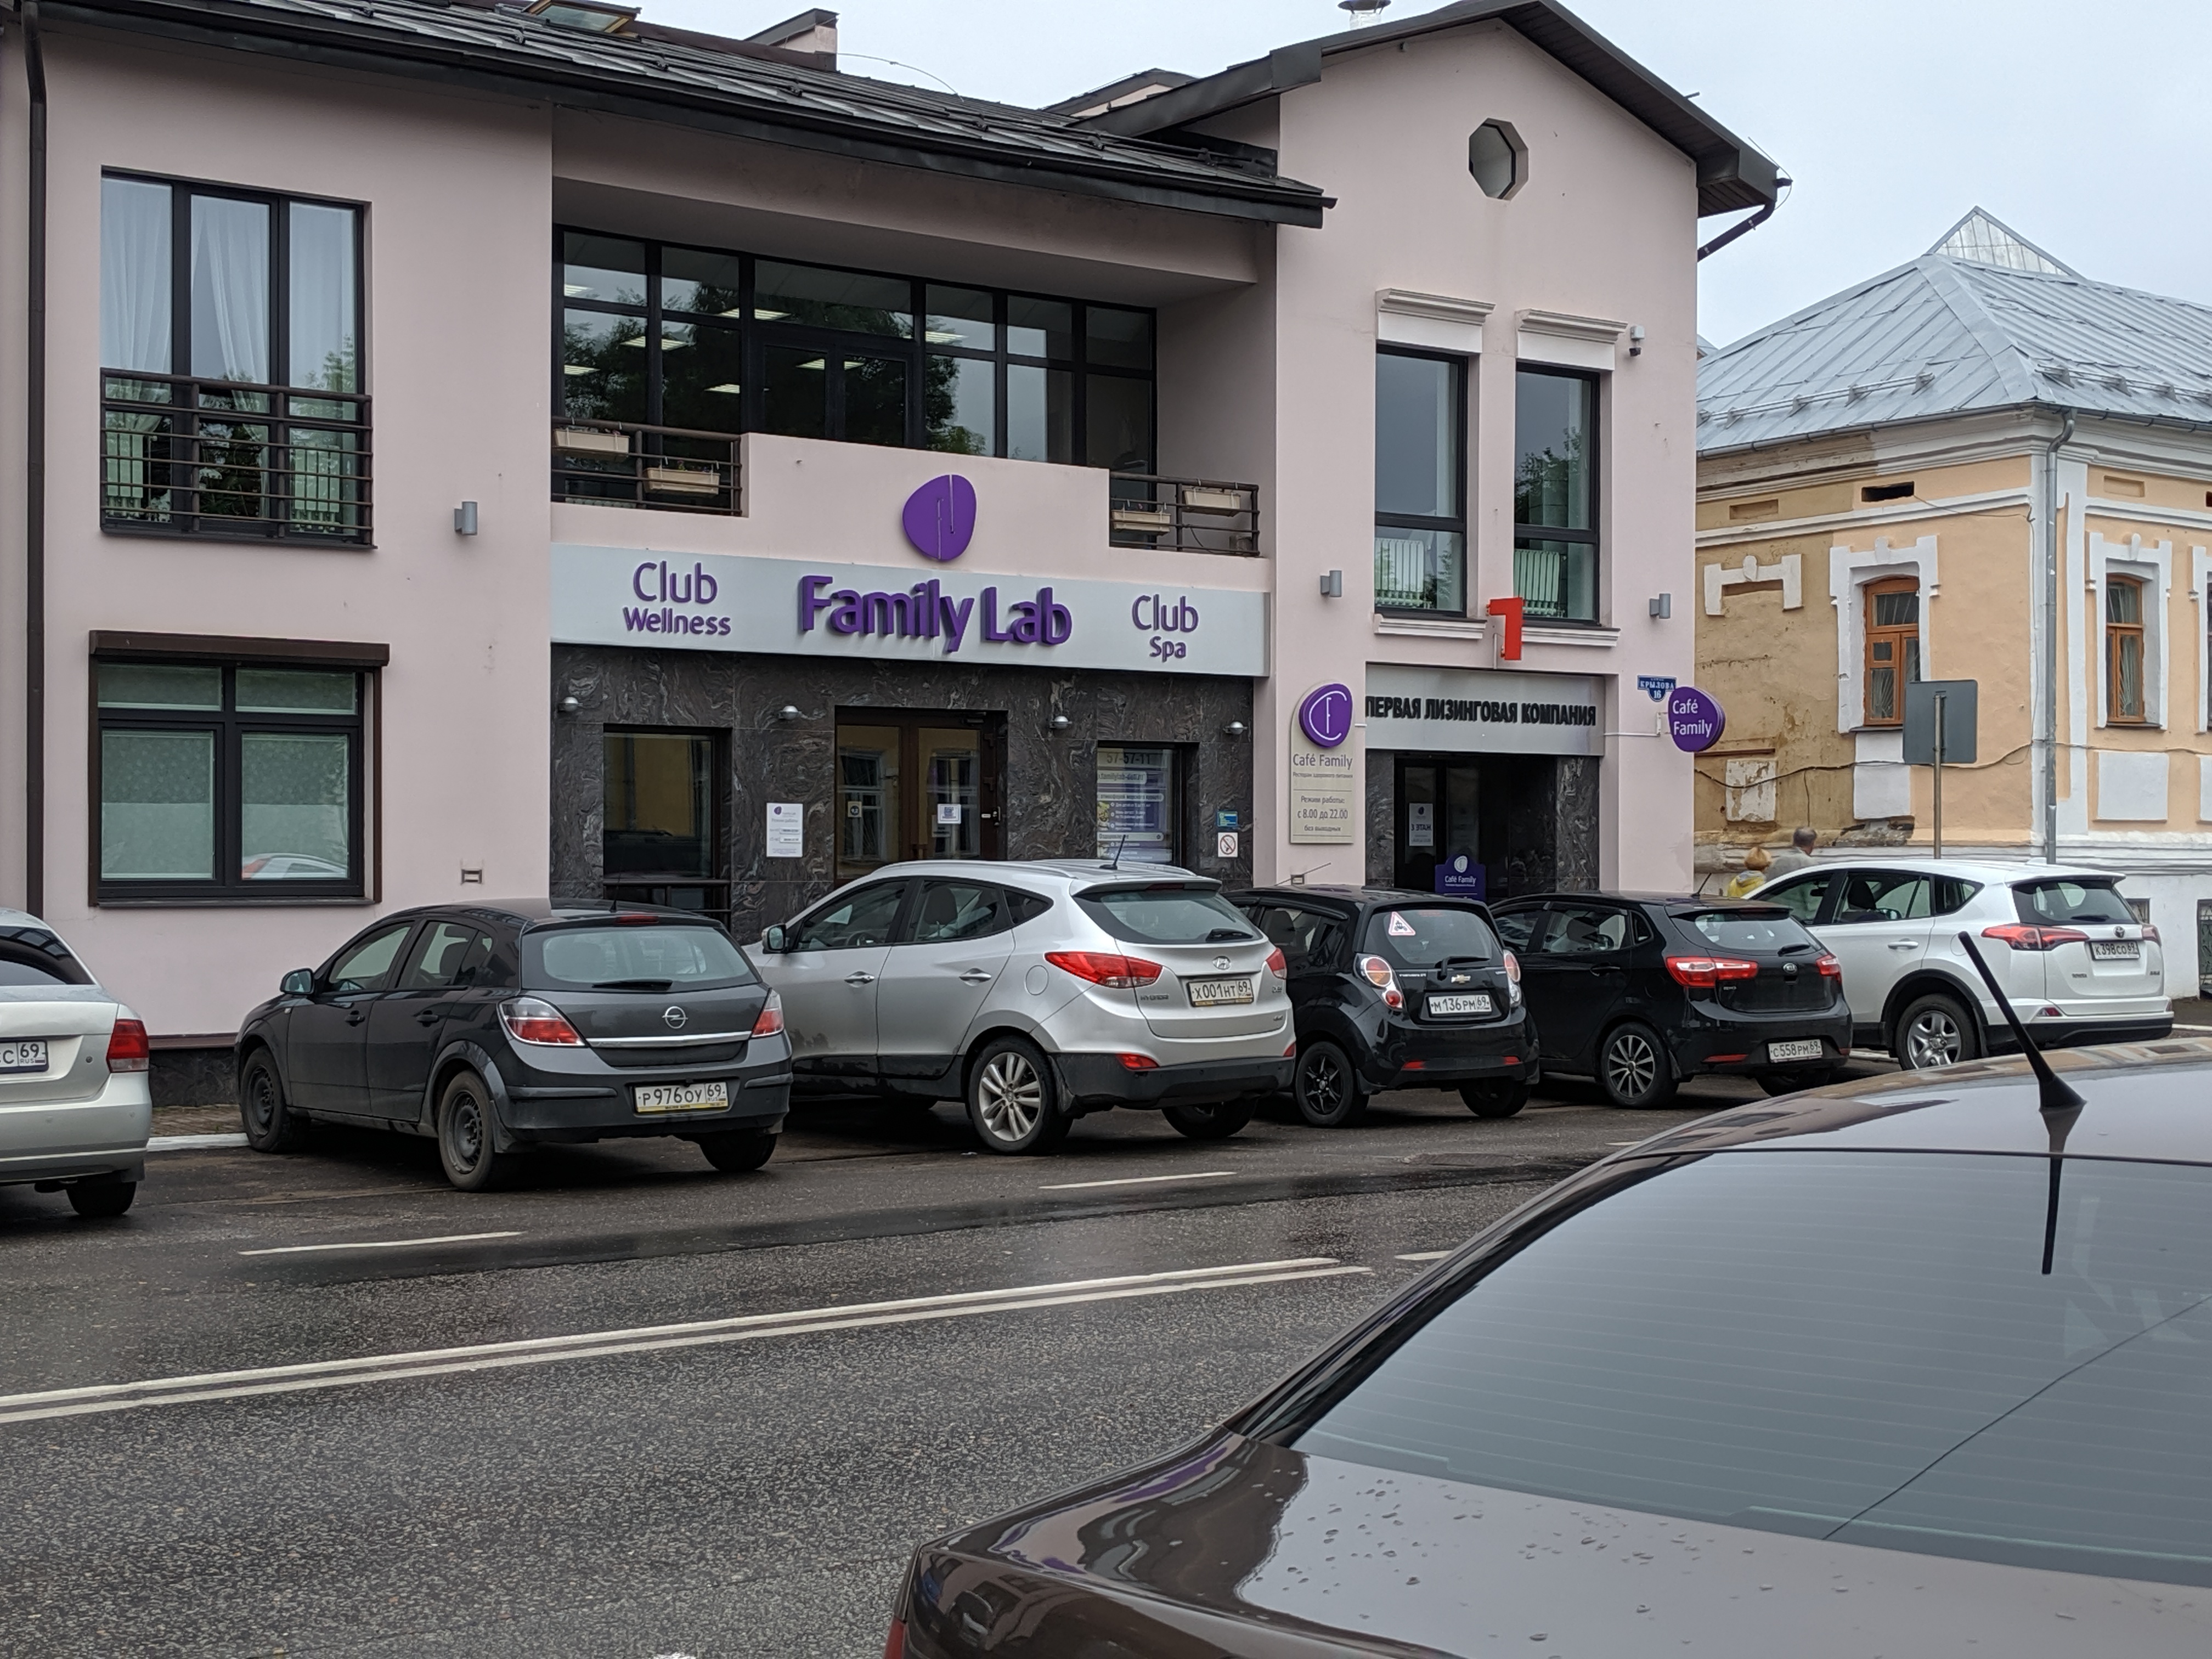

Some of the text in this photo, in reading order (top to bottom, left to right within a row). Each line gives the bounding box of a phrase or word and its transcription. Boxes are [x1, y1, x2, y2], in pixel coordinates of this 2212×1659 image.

[633, 560, 718, 604] Club
[623, 607, 731, 636] Wellness
[798, 575, 1073, 653] Family Lab
[1132, 594, 1199, 633] Club
[1149, 636, 1186, 663] Spa
[1640, 681, 1674, 689] КРЫЛОВА
[1654, 690, 1662, 699] 16
[1365, 696, 1596, 726] ПЕРВАЯ ЛИЗИНГОВАЯ КОМПАНИЯ
[1673, 698, 1699, 714] Café
[1674, 719, 1712, 738] Family
[1293, 753, 1353, 770] Café Family
[1302, 809, 1317, 819] 8.00
[1319, 811, 1329, 820] до
[1329, 809, 1348, 820] 22.00
[1458, 875, 1477, 884] Family
[20, 1043, 40, 1058] 69
